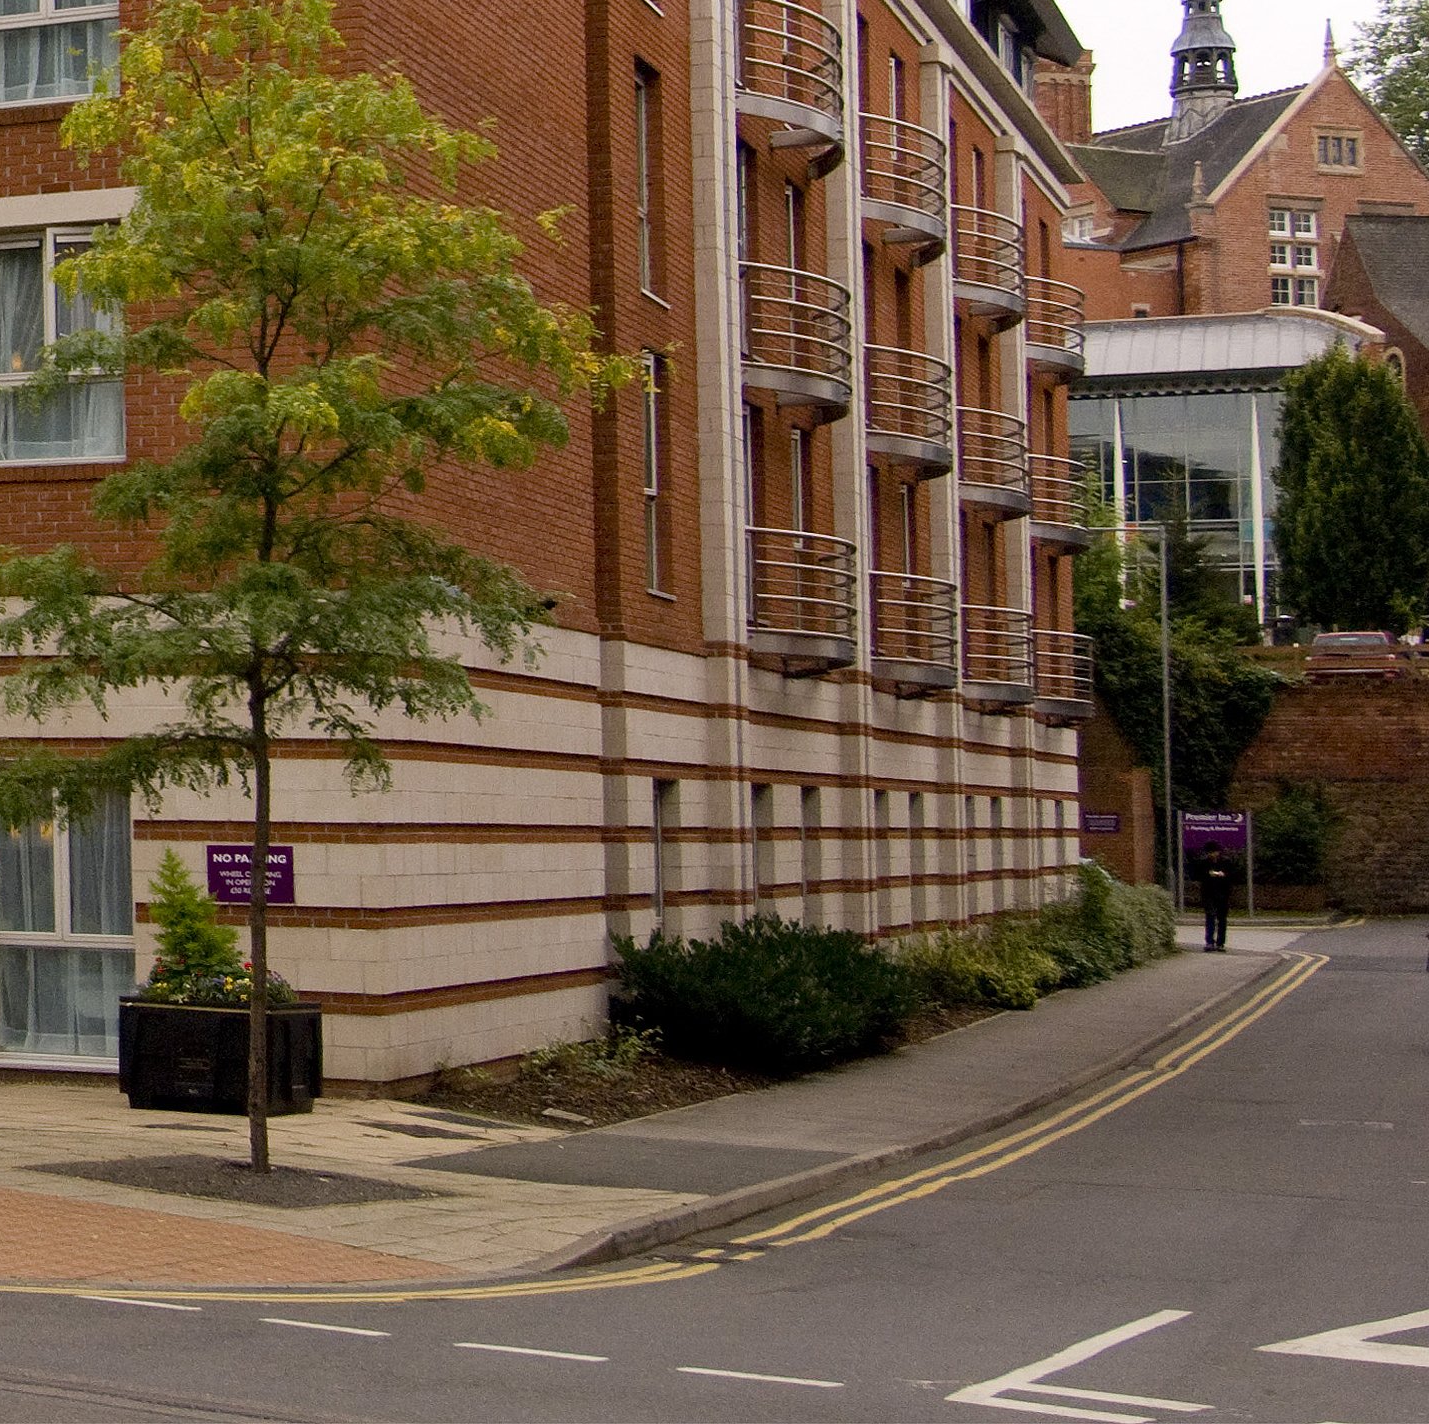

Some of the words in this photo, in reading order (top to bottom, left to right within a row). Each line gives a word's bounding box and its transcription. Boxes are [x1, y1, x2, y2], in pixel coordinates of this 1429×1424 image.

[213, 854, 232, 863] NO
[235, 854, 287, 864] PAING
[219, 870, 244, 878] WHEEL
